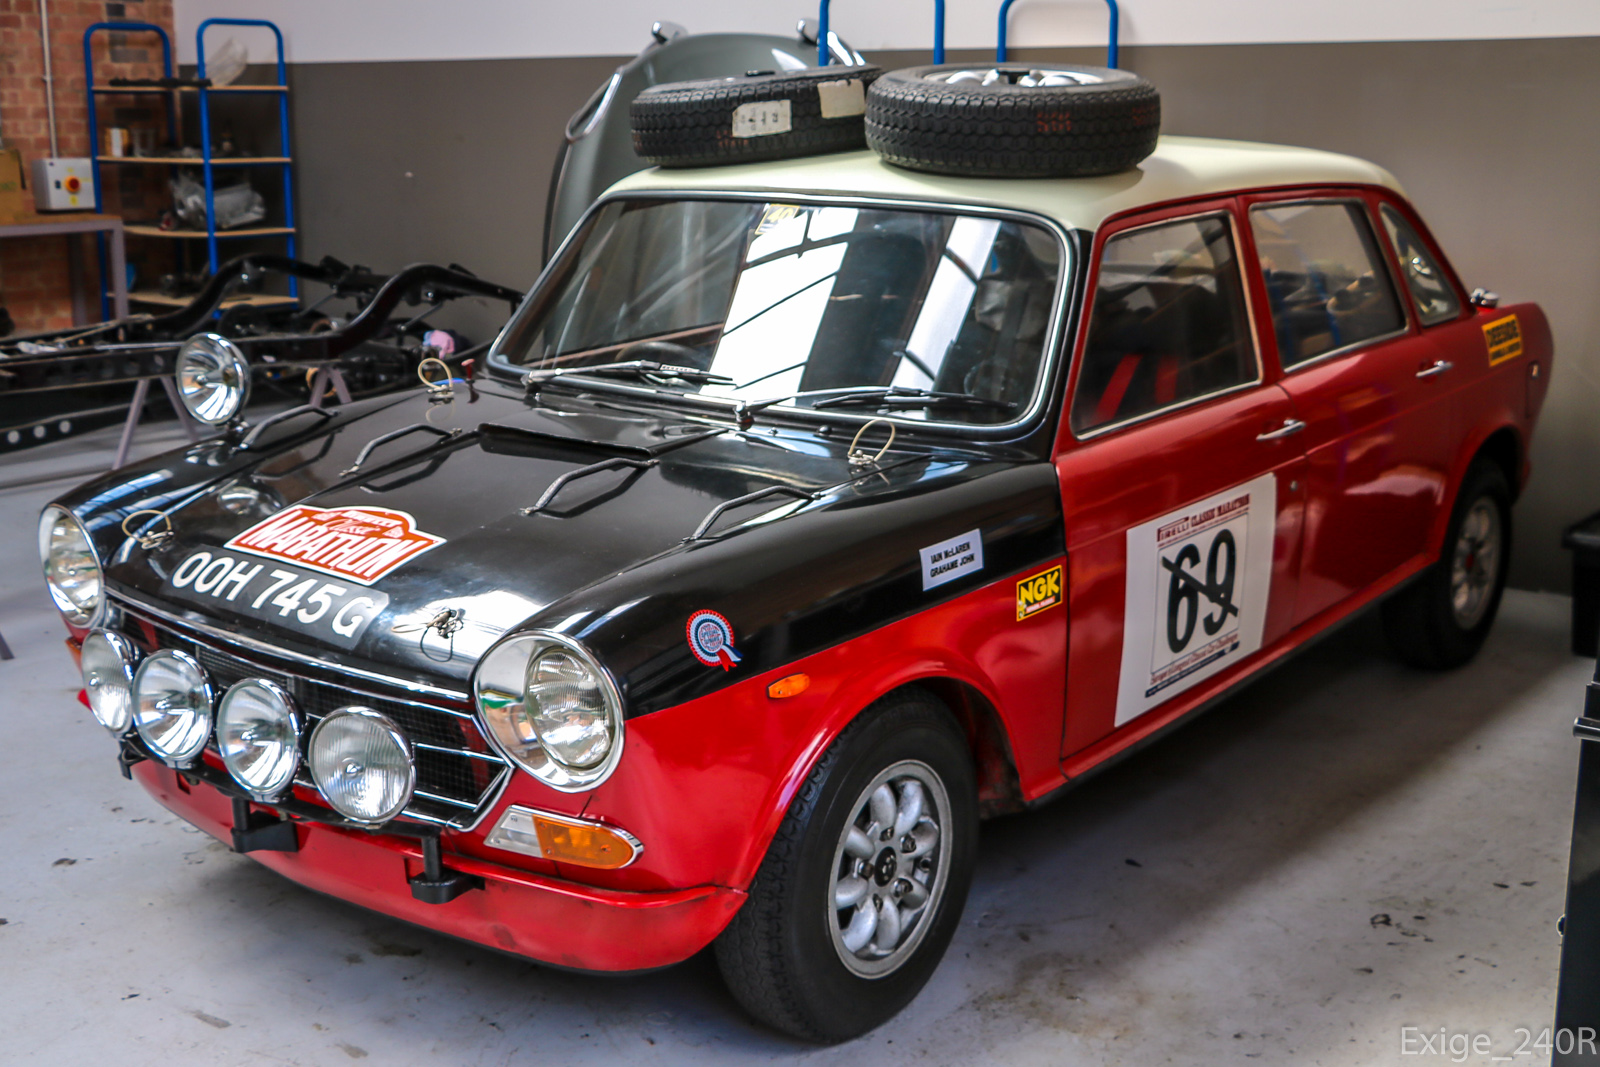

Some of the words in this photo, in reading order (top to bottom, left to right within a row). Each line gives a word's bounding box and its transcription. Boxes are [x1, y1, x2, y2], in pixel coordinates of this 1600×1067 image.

[241, 509, 427, 577] MARATHON
[1157, 515, 1190, 542] PIRELLI
[929, 559, 958, 578] GRAHAME
[959, 552, 975, 568] JOHN
[930, 551, 943, 564] IAIN
[944, 541, 971, 560] McLAREN
[171, 551, 264, 601] OOH
[251, 568, 348, 625] 745
[331, 596, 375, 638] G
[1019, 569, 1060, 604] NGK
[1167, 528, 1237, 654] 69
